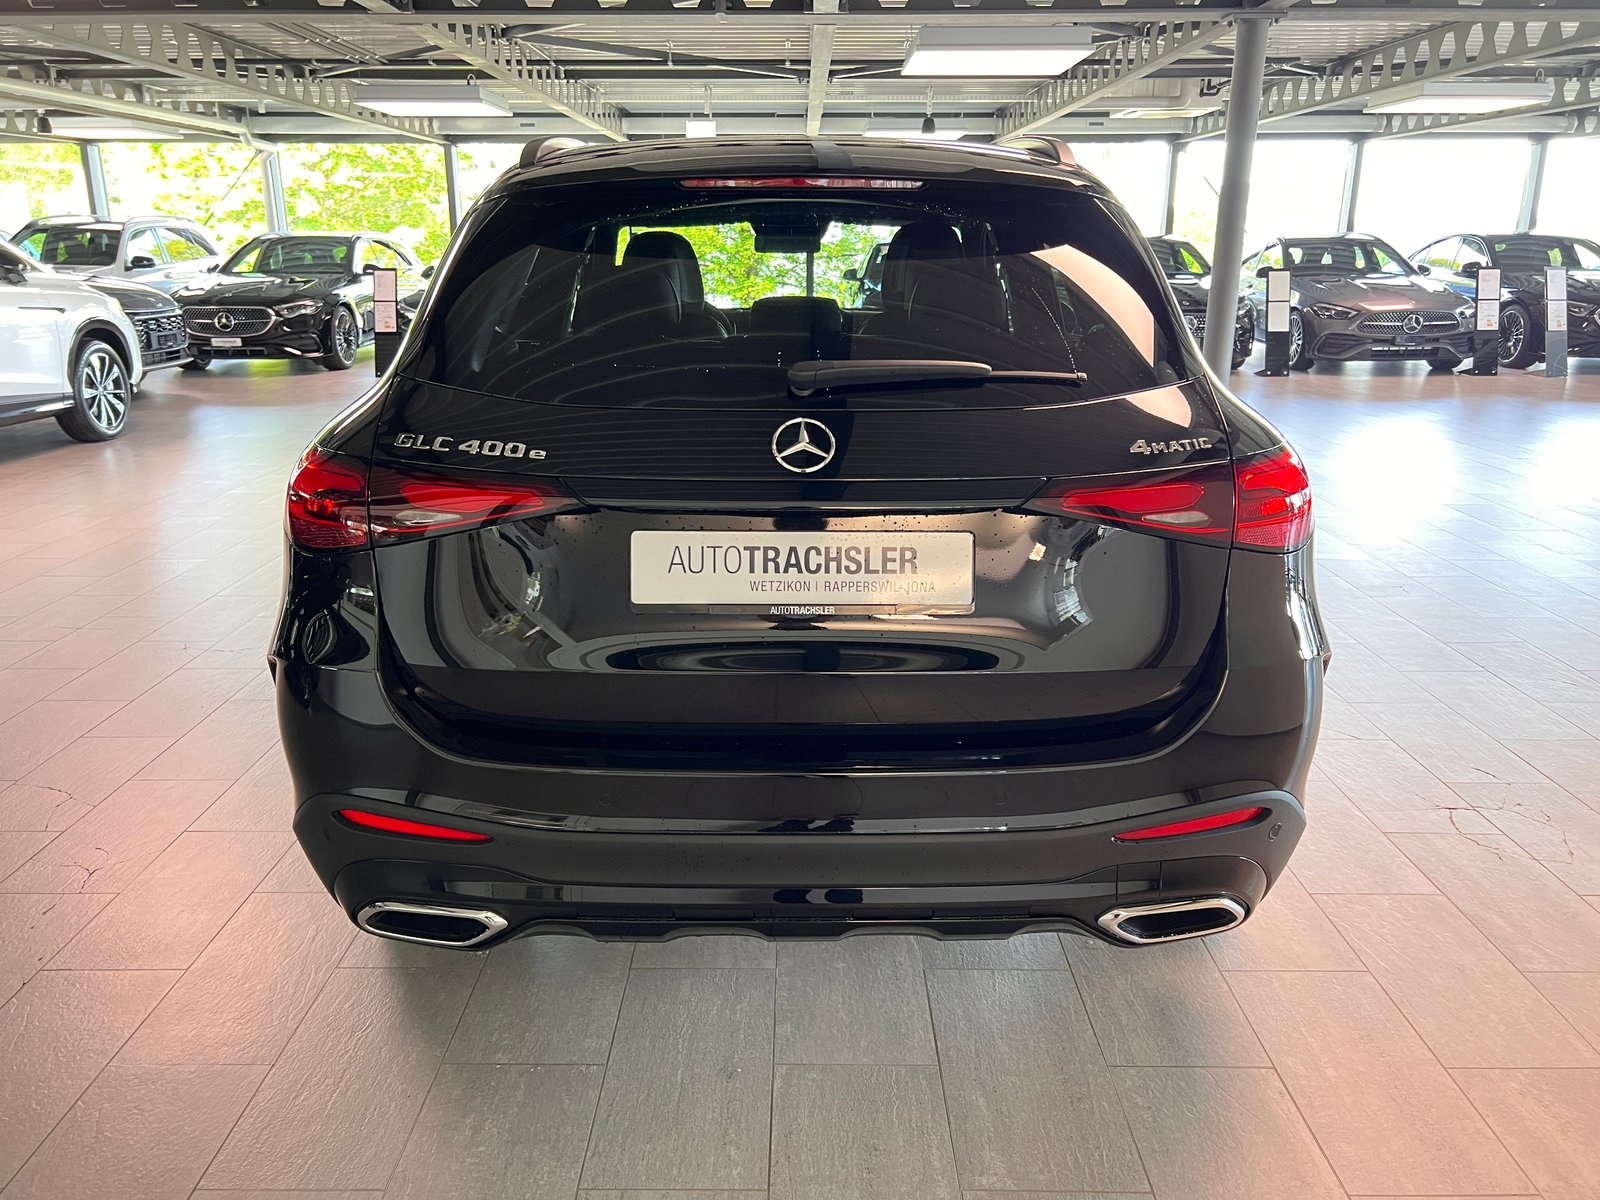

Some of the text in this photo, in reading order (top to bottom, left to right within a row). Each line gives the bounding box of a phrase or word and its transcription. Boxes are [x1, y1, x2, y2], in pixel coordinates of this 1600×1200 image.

[394, 432, 454, 452] GLC
[1129, 437, 1212, 455] 4MATIC
[668, 545, 918, 575] AUTOTRACHSLER
[749, 580, 811, 593] WETZIKON
[824, 580, 936, 593] RAPPERSWIL-JONA
[770, 606, 835, 615] AUTOTRACHSLER
